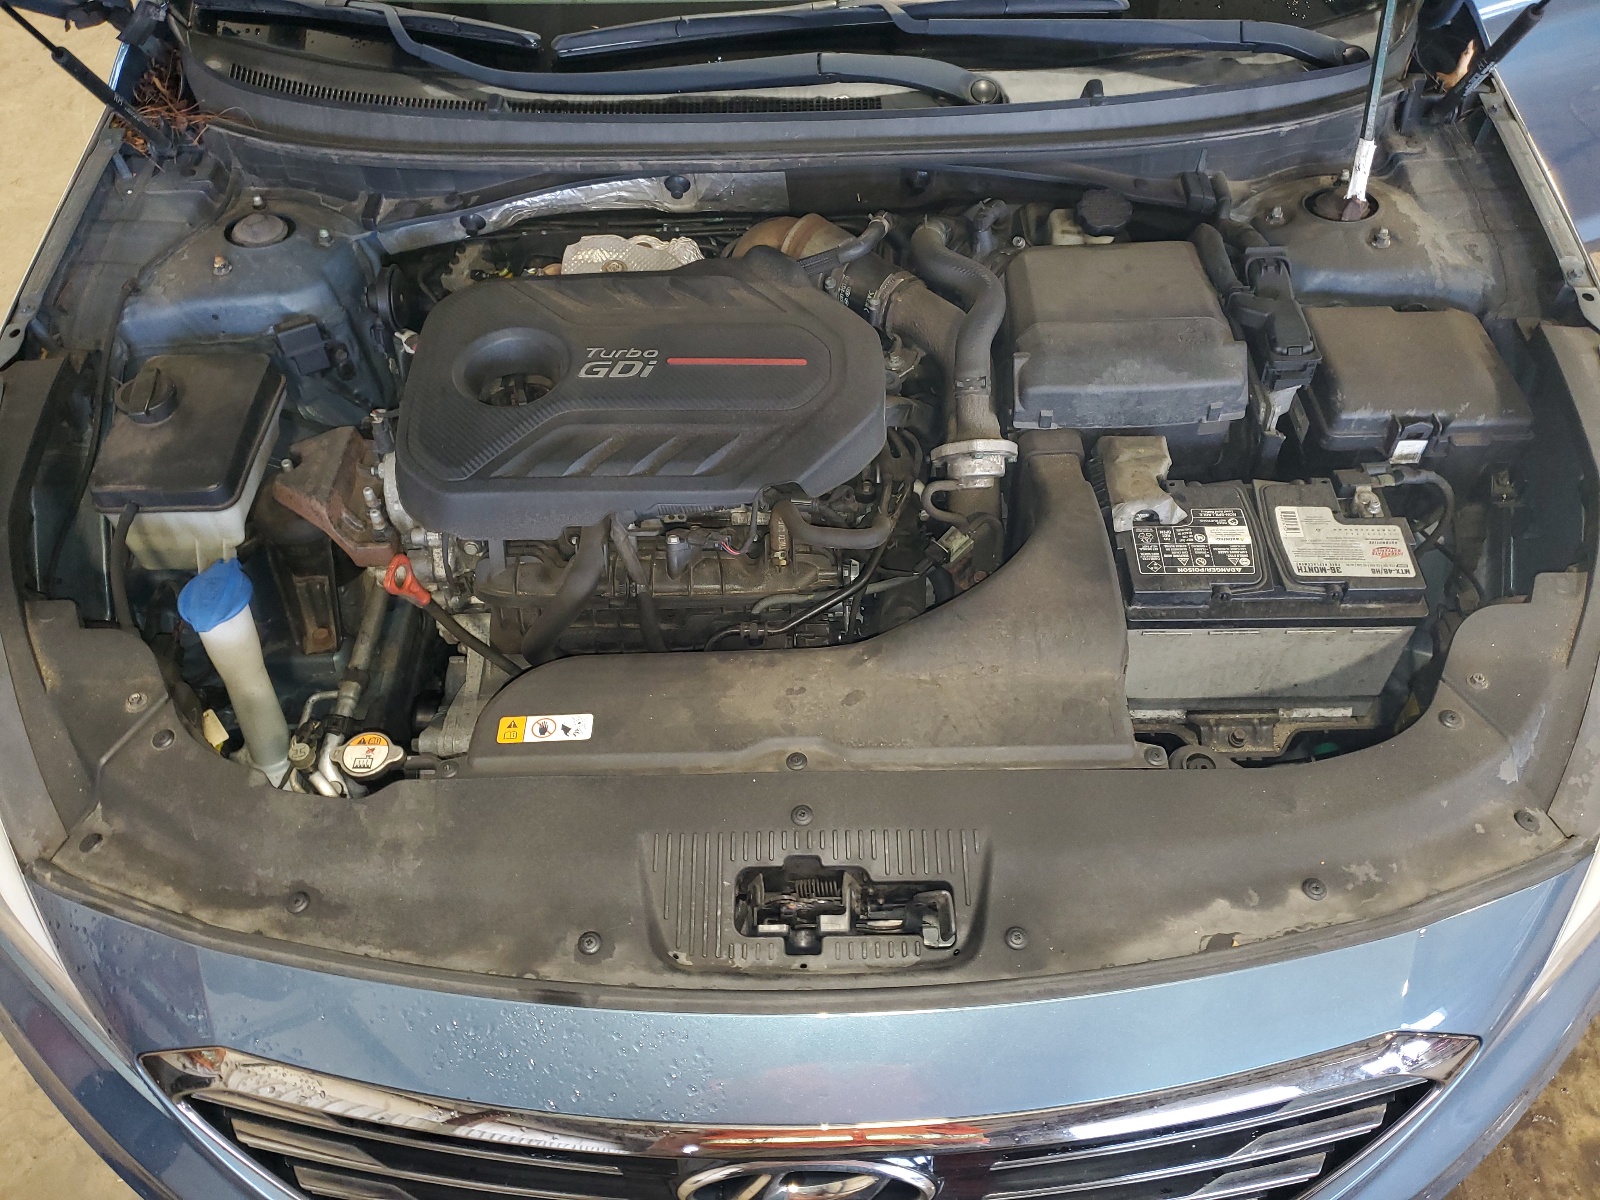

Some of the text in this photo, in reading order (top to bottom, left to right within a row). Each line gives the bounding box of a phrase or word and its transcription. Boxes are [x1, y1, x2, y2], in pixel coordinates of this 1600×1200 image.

[586, 347, 659, 358] Turbo
[577, 360, 658, 378] GDi
[1296, 566, 1342, 574] 36-MONTH
